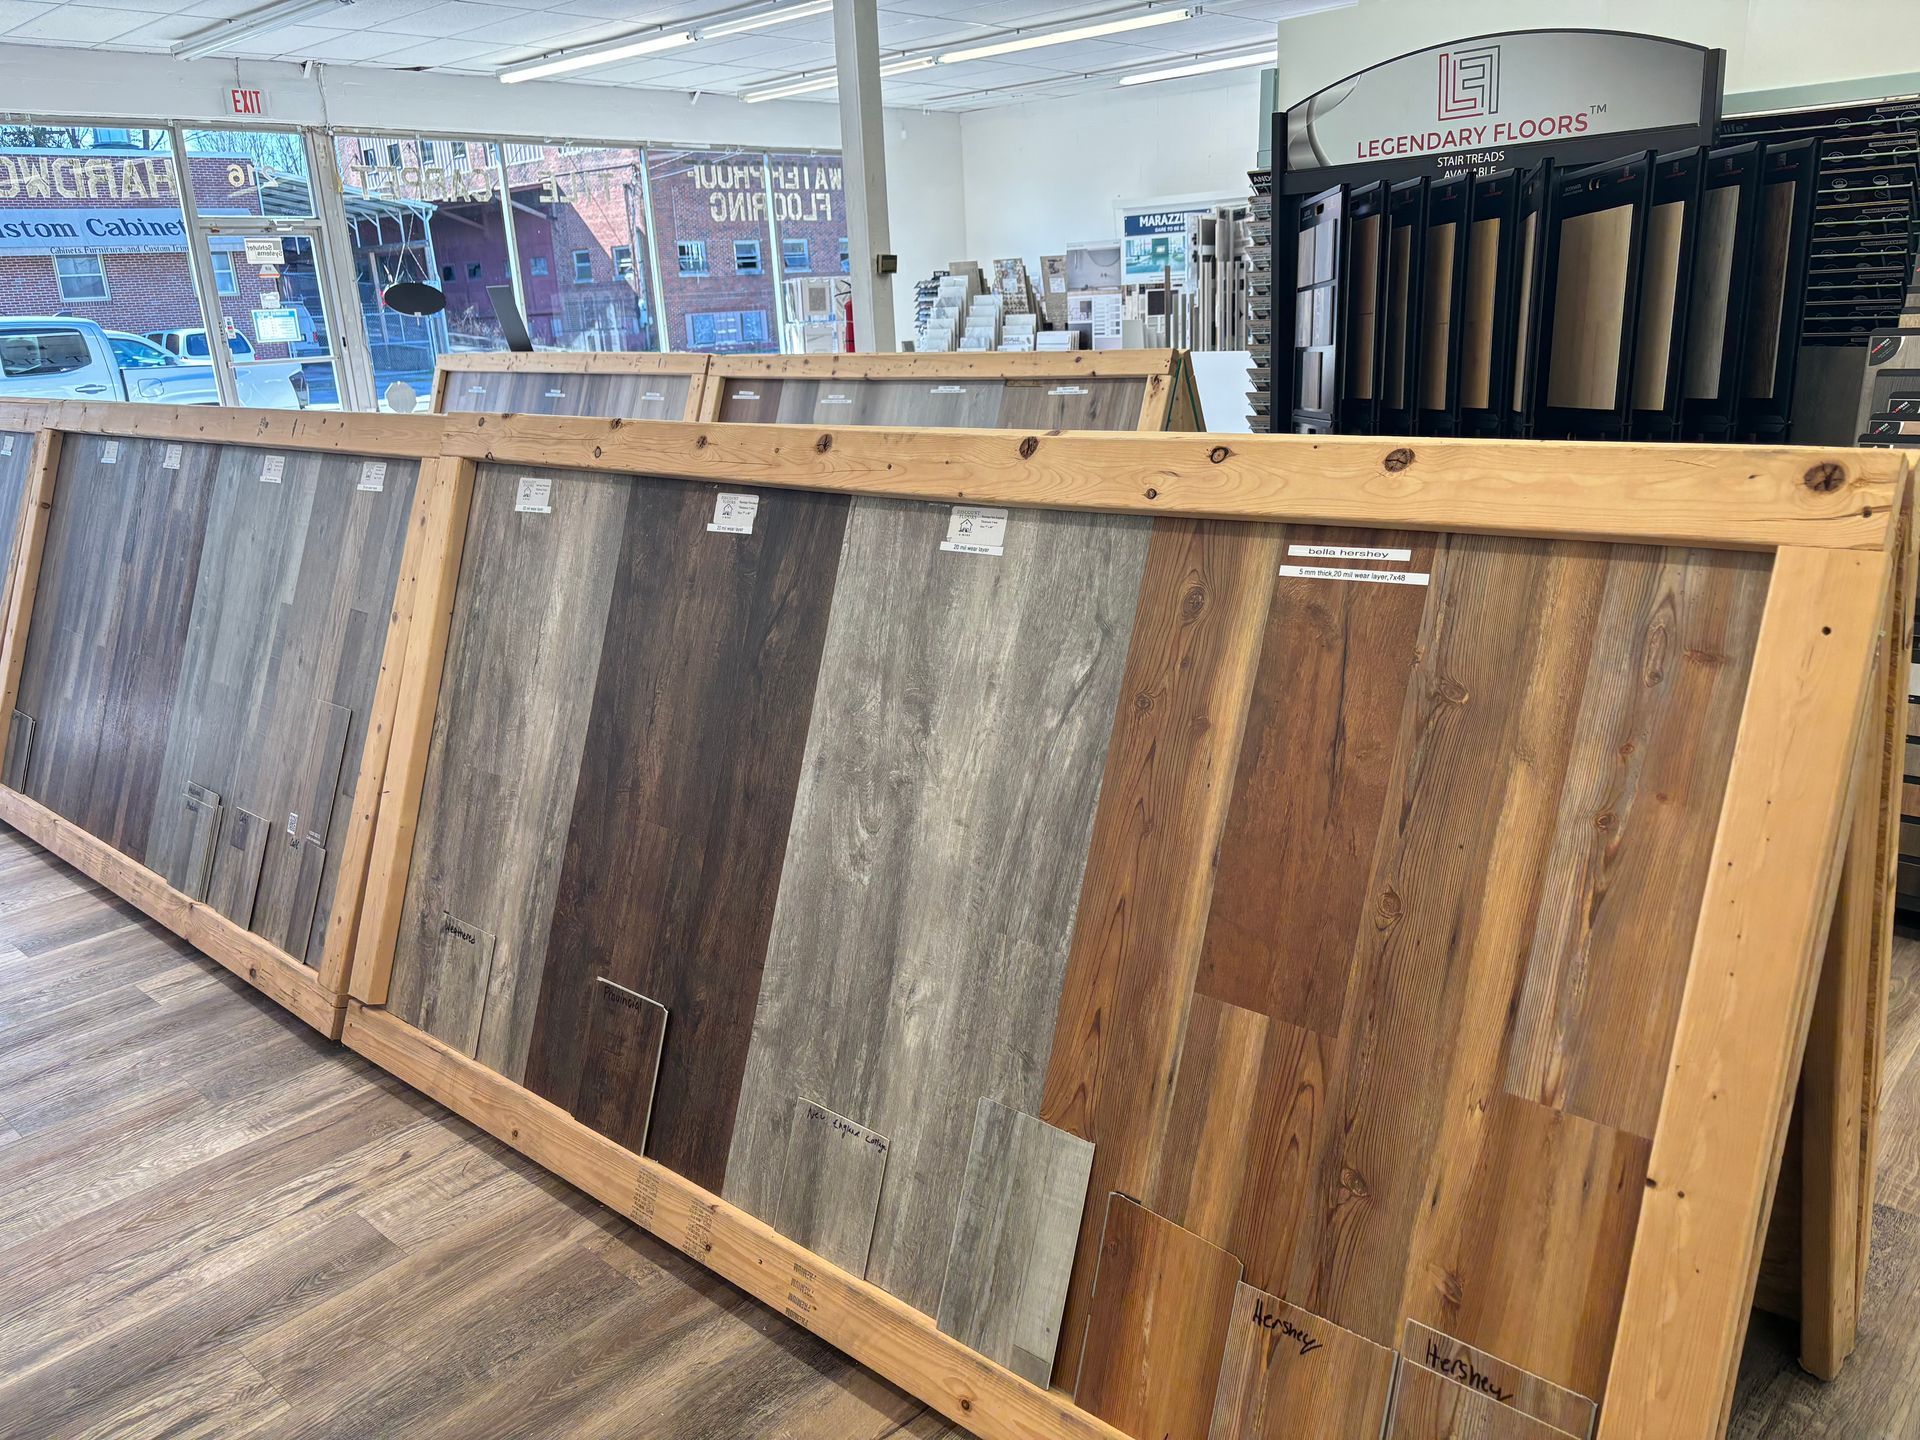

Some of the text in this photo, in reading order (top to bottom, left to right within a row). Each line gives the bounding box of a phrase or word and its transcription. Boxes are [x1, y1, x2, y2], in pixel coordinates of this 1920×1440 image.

[231, 89, 262, 114] EXIT
[1357, 125, 1487, 159] LEGENDARY
[1493, 112, 1589, 143] FLOORS
[1437, 150, 1505, 168] STAIR TREADS
[1253, 175, 1272, 183] AND
[0, 219, 79, 239] stom
[1139, 212, 1184, 228] MARAZZI
[1308, 547, 1389, 559] bella hershey
[1252, 1297, 1323, 1356] Hershey
[1425, 1337, 1513, 1401] Hershey
